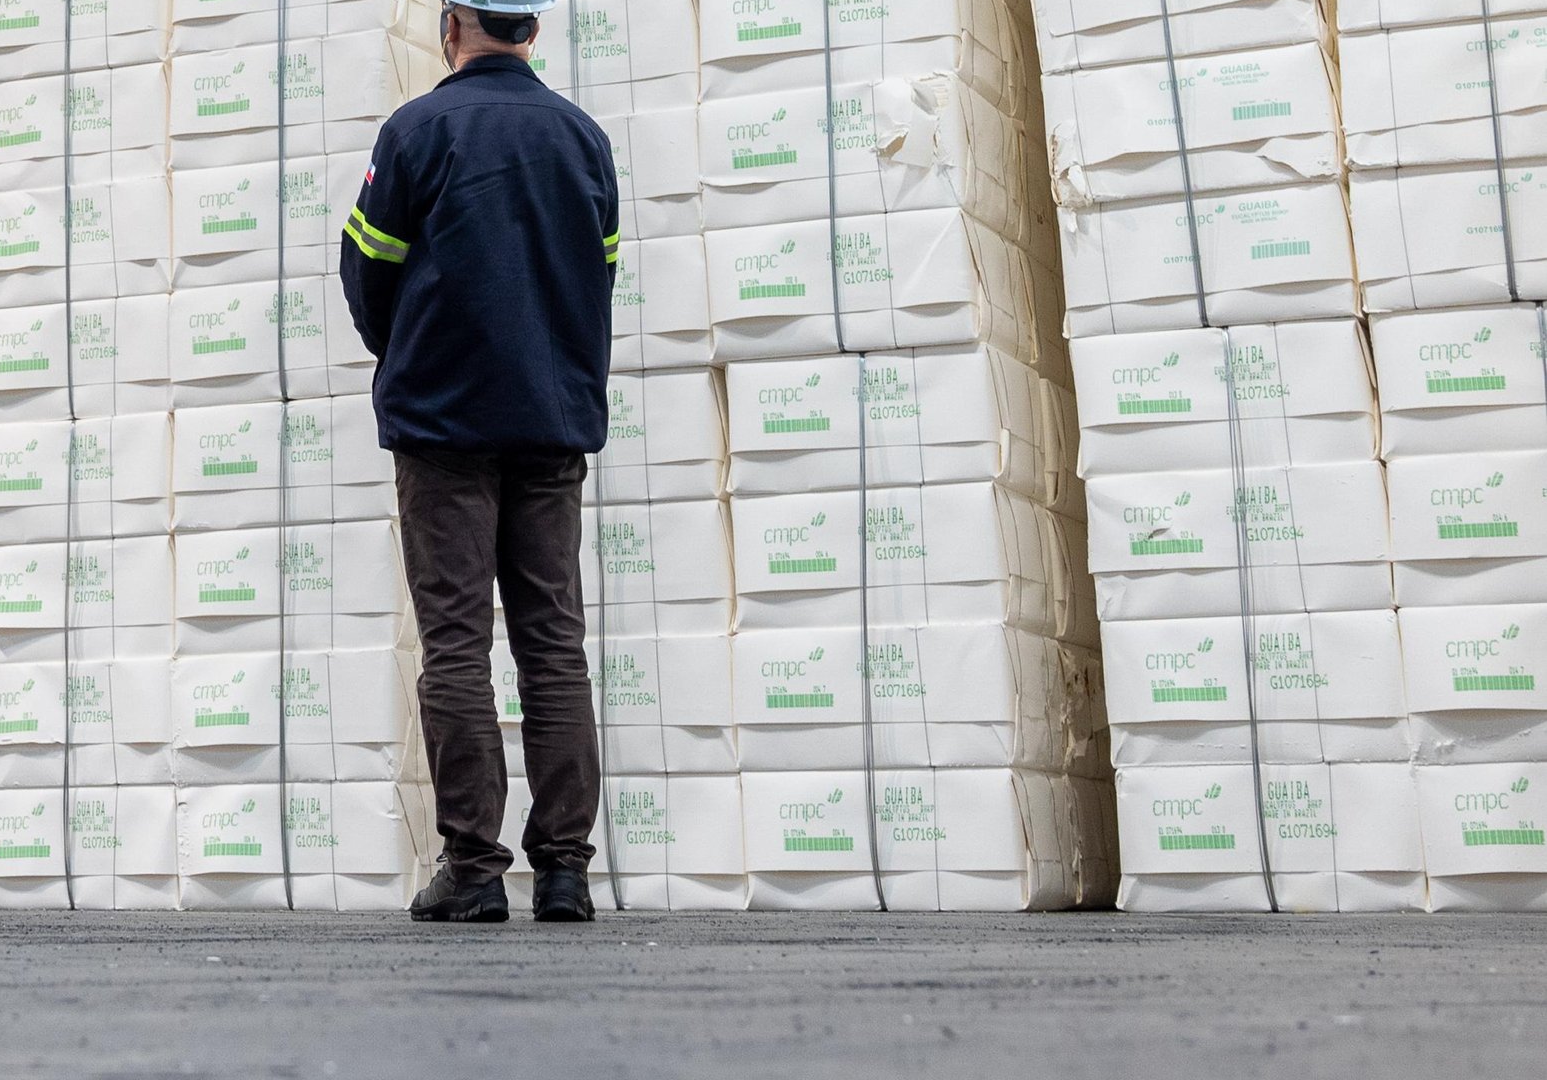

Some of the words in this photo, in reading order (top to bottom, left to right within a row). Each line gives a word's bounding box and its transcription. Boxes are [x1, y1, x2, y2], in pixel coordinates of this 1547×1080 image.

[70, 2, 107, 17] G1071694
[839, 6, 889, 22] G1071694
[581, 44, 627, 59] G1071694
[1220, 63, 1261, 74] GUAIBA
[194, 74, 231, 92] cmpc
[282, 86, 324, 100] G1071694
[831, 99, 862, 116] UAIBA
[72, 118, 111, 131] G1071694
[727, 122, 770, 141] cmpc
[835, 135, 877, 150] G107169
[283, 172, 314, 188] GUAIBA
[199, 191, 235, 209] cmpc
[1239, 201, 1279, 212] GUAIBA
[289, 205, 331, 219] G1071694
[71, 230, 110, 243] G1071694
[835, 233, 870, 251] GUAIBA
[735, 254, 778, 272] cmpc
[844, 269, 893, 284] G1071694
[75, 313, 102, 329] GUAIBA
[190, 312, 225, 330] cmpc
[281, 324, 322, 339] G1071694
[80, 346, 118, 360] G1071694
[1230, 346, 1264, 364] UAIBA
[1420, 342, 1472, 363] cmpc
[1113, 367, 1161, 386] cmpc
[759, 387, 804, 406] cmpc
[1234, 384, 1290, 400] G1071694
[870, 405, 921, 420] G1071694
[285, 416, 316, 431] GUAIBA
[199, 432, 236, 451] cmpc
[291, 448, 333, 462] G1071694
[74, 466, 114, 481] G1071694
[1236, 486, 1277, 505] GUAIBA
[1431, 487, 1484, 507] cmpc
[867, 507, 904, 525] GUAIBA
[1124, 506, 1172, 525] cmpc
[764, 527, 809, 546] cmpc
[1246, 526, 1304, 542] G1071694
[876, 545, 927, 560] G1071694
[197, 558, 234, 576] cmpc
[608, 560, 655, 574] G1071694
[289, 577, 333, 592] G1071694
[74, 590, 114, 603] G1071694
[1259, 633, 1301, 651] GUAIBA
[1446, 639, 1499, 660] cmpc
[866, 645, 903, 662] GUAIBA
[762, 661, 806, 679] cmpc
[1146, 652, 1195, 672] cmpc
[1270, 674, 1329, 690] G1071694
[193, 683, 230, 700] cmpc
[874, 684, 926, 698] G1071694
[607, 693, 656, 706] G1071694
[72, 710, 112, 723] G1071694
[285, 703, 329, 717] G1071694
[885, 787, 923, 804] GUAIBA
[1268, 781, 1310, 799] GUAIBA
[290, 798, 321, 814] GUAIBA
[619, 792, 654, 808] GUAIBA
[1455, 792, 1509, 813] cmpc
[76, 801, 105, 816] GUAIBA
[780, 802, 825, 822] cmpc
[1153, 798, 1202, 819] cmpc
[202, 813, 239, 829] cmpc
[627, 831, 675, 844] G1071694
[893, 828, 946, 841] G1071694
[1279, 824, 1337, 838] G1071694
[82, 835, 122, 849] G1071694
[296, 833, 338, 848] G1071694
